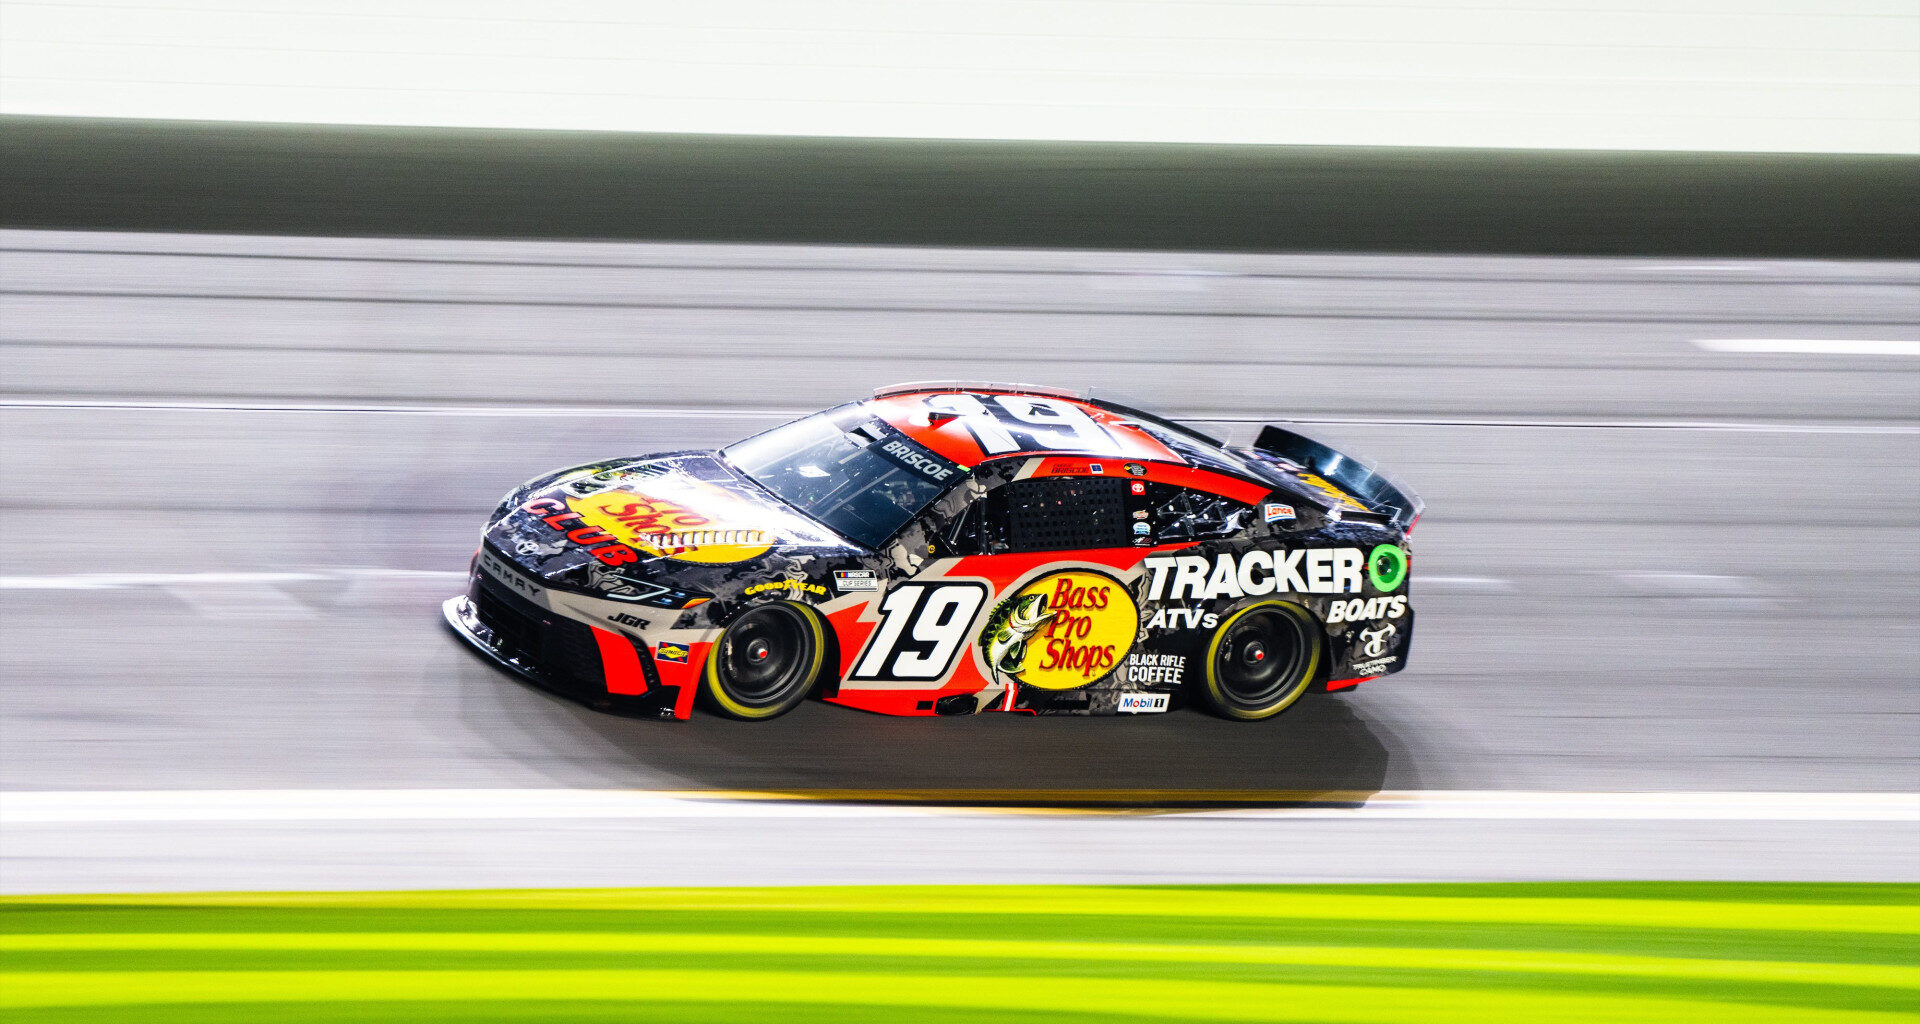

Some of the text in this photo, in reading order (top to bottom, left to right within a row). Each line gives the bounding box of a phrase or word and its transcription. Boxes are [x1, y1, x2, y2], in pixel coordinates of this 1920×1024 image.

[882, 440, 954, 481] BRISCOE
[1266, 505, 1293, 517] Lance
[521, 497, 639, 567] CLUB
[483, 554, 541, 597] CAMRY
[744, 579, 827, 595] GOODYEAR
[1144, 547, 1365, 601] TRACKER
[1048, 578, 1111, 608] Bass
[607, 612, 651, 630] JGR
[1044, 609, 1092, 638] Pro
[1146, 608, 1220, 629] ATVs
[1326, 595, 1408, 624] BOATS
[851, 584, 986, 679] 19
[1039, 638, 1115, 677] Shops
[1129, 654, 1187, 668] BLACK RIFLE
[1128, 666, 1184, 685] COFFEE
[1123, 698, 1165, 708] Mobil 1
